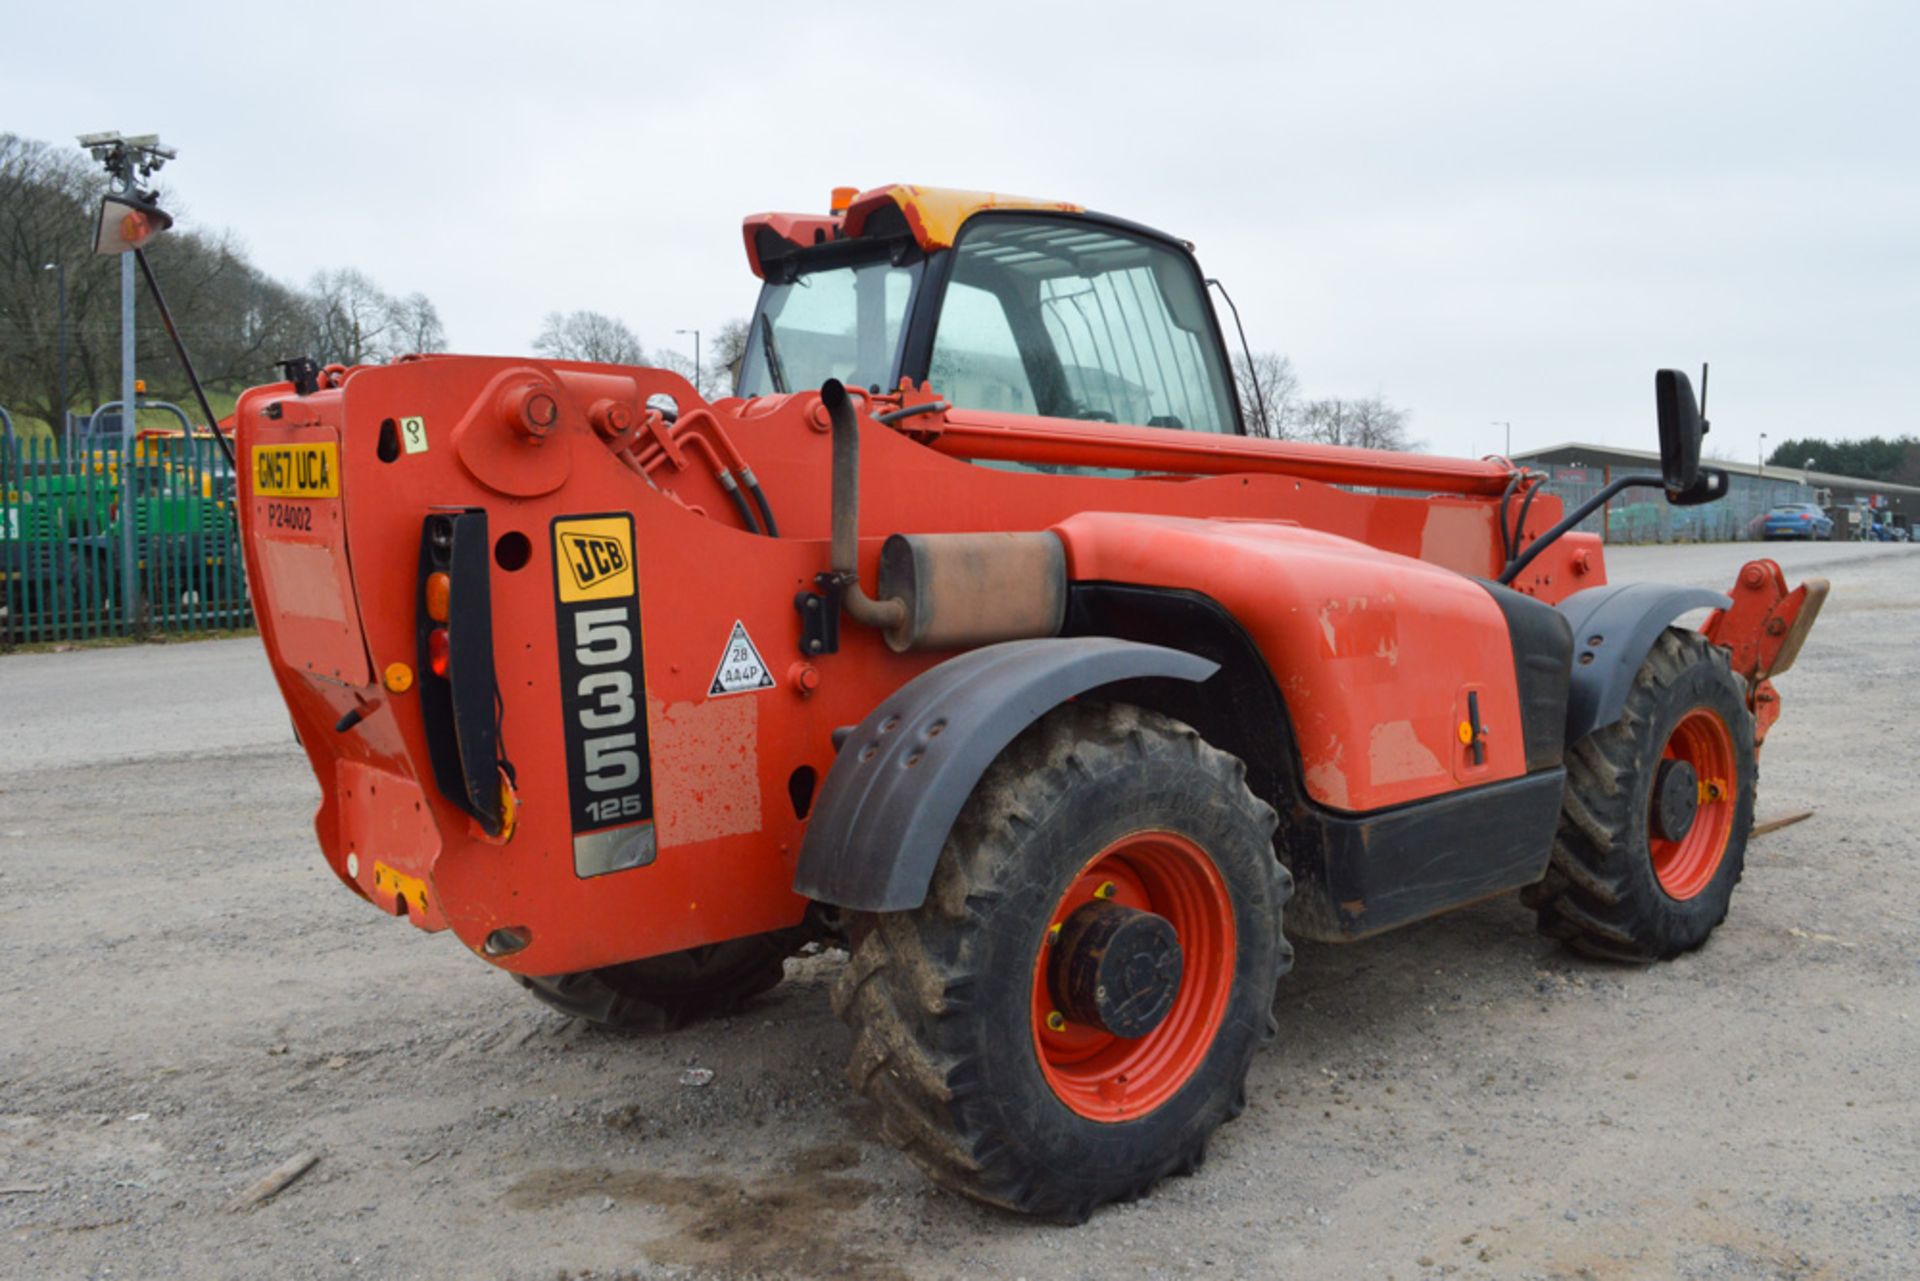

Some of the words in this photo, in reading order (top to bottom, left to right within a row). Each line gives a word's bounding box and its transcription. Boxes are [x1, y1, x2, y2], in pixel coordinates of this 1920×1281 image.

[258, 451, 292, 489] GN57
[296, 450, 330, 490] UCA
[268, 503, 313, 532] P24002
[573, 538, 624, 583] JCB
[732, 648, 748, 663] 28
[725, 666, 758, 683] AA4P
[584, 794, 642, 823] 125
